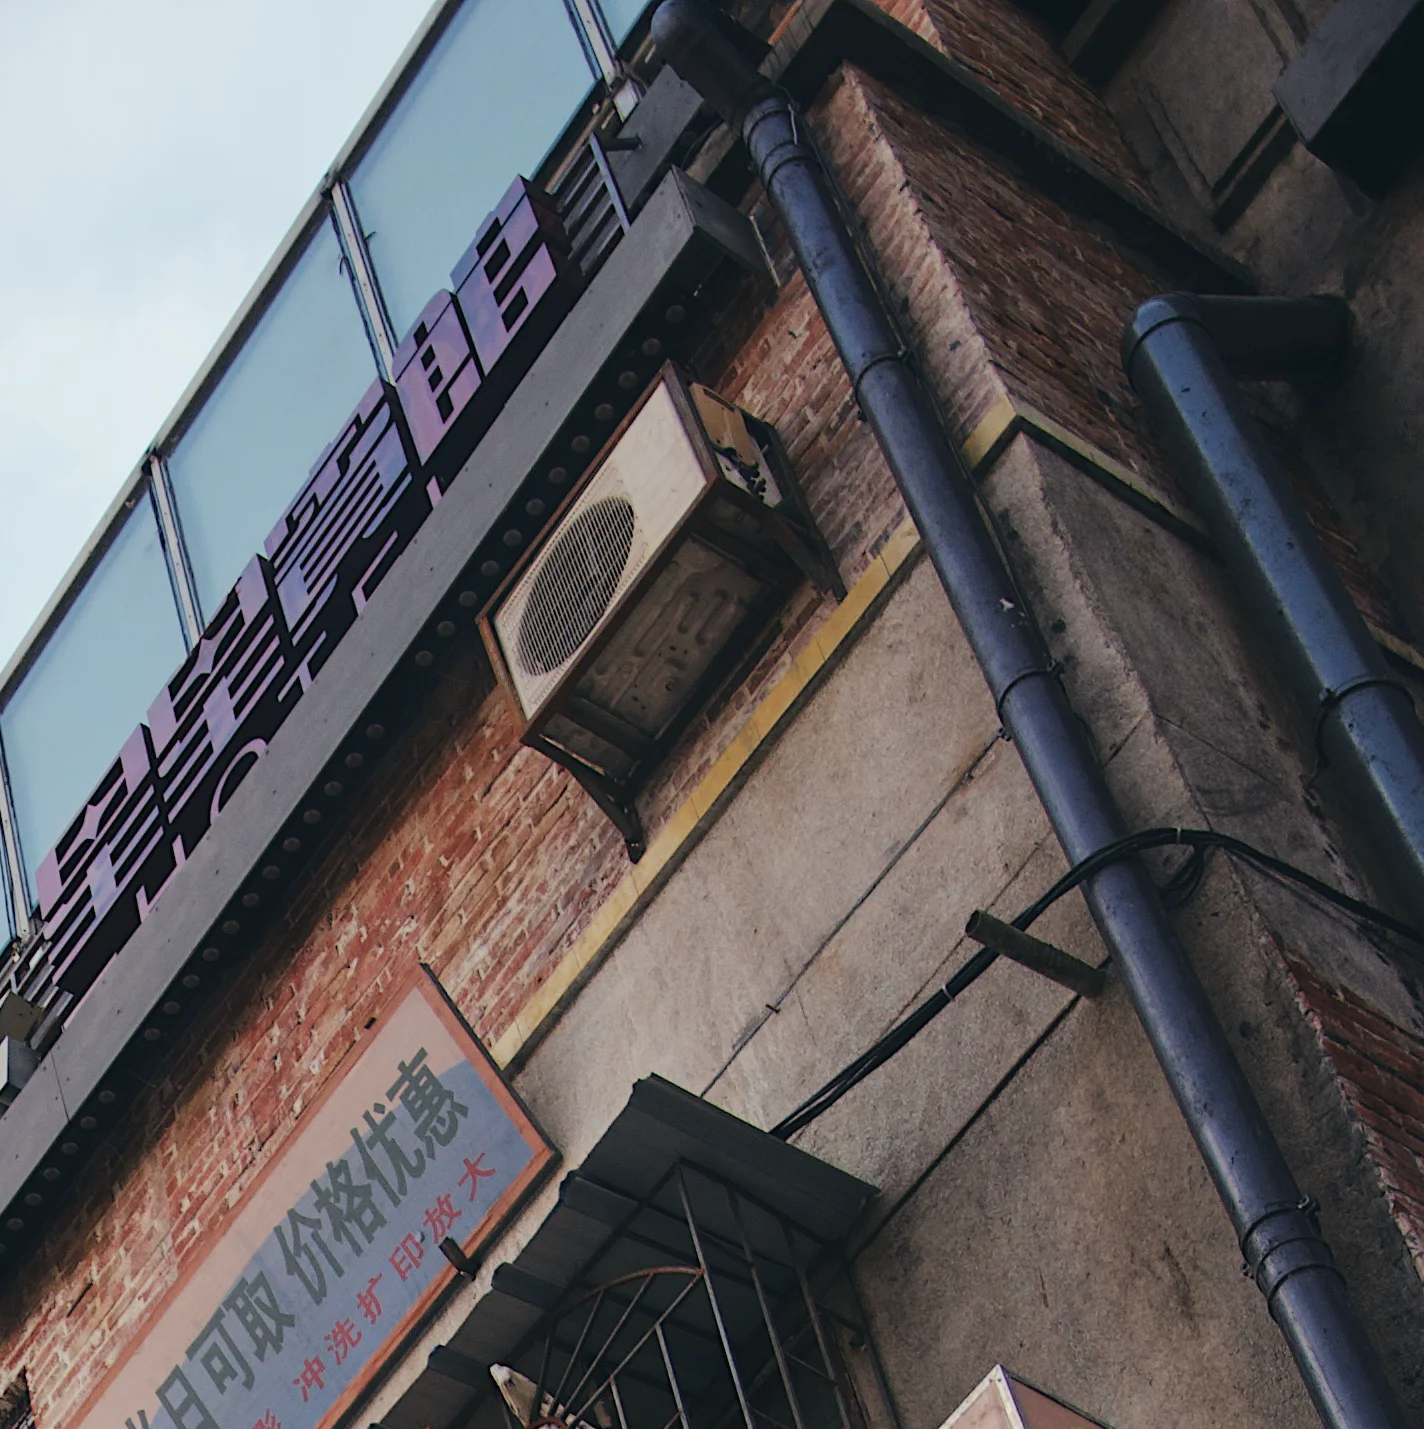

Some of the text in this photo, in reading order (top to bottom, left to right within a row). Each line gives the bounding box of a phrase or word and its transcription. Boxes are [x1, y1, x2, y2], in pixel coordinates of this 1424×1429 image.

[275, 1046, 471, 1307] 价格优惠
[290, 1152, 496, 1405] 冲洗扩印放大
